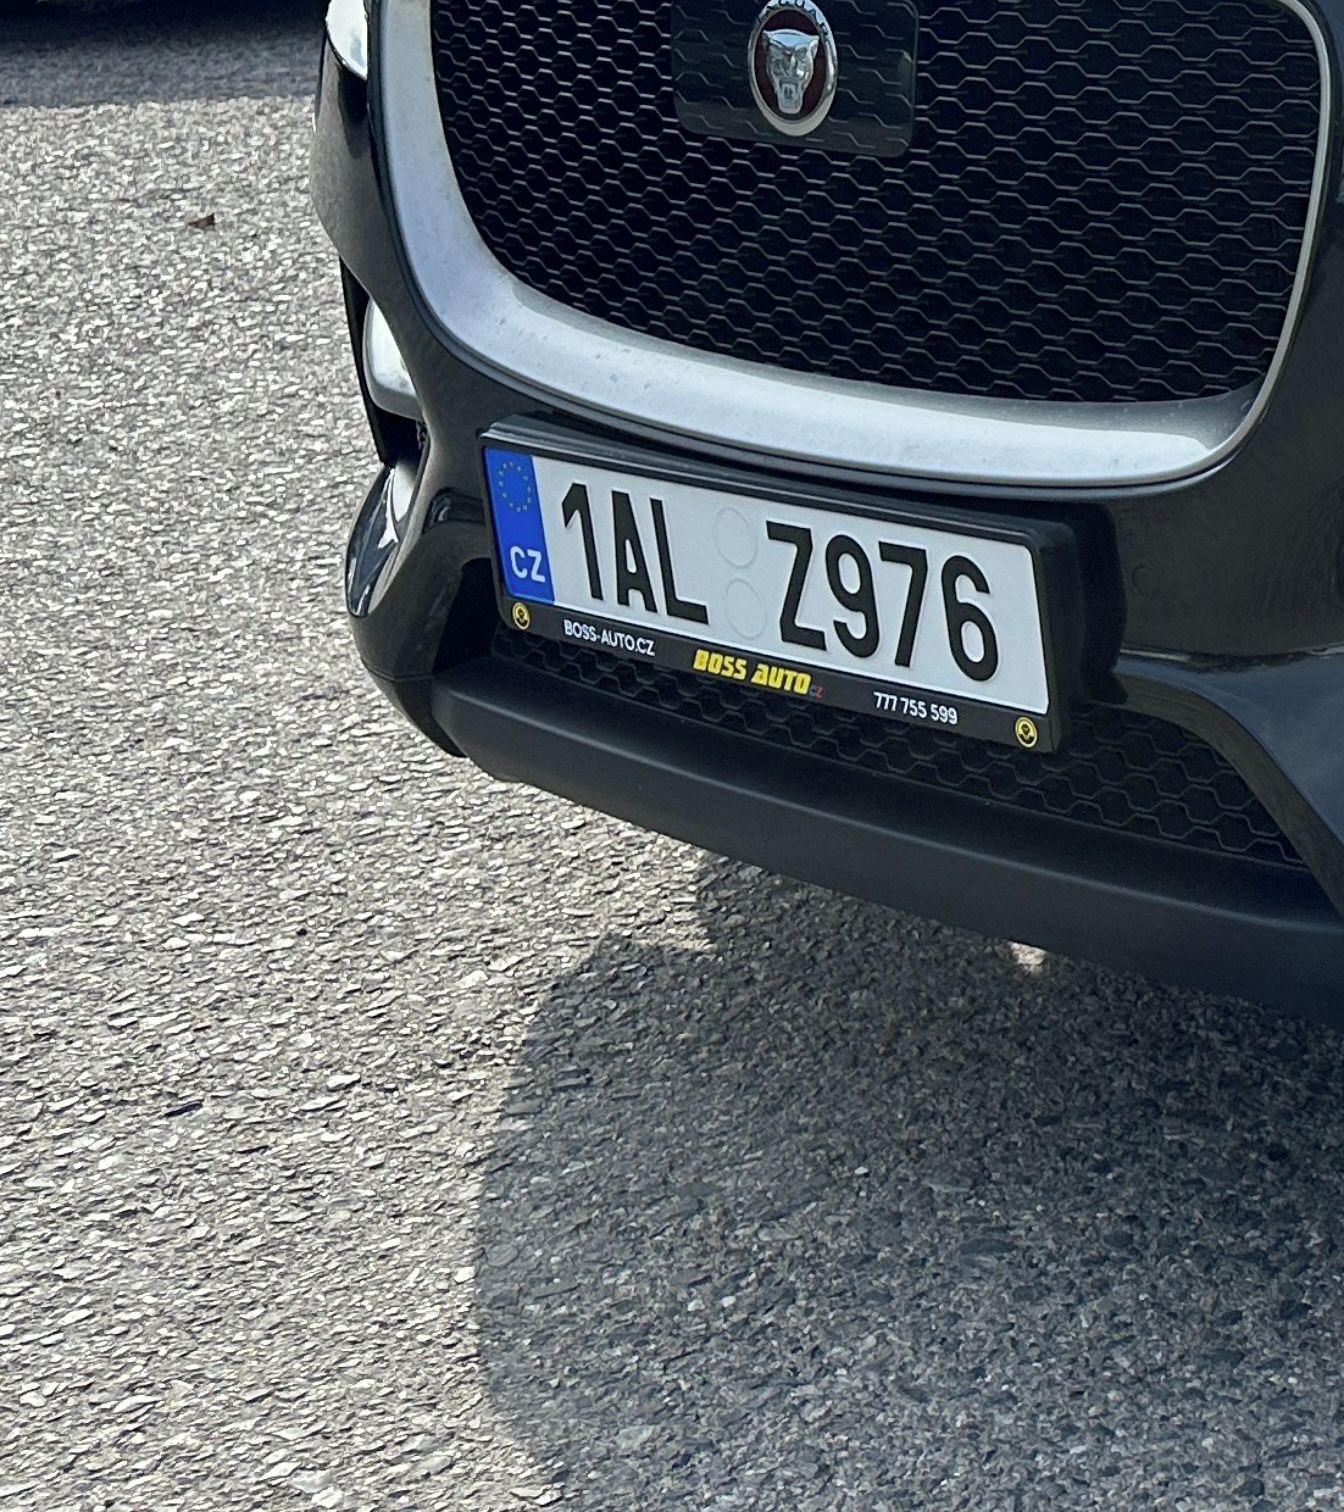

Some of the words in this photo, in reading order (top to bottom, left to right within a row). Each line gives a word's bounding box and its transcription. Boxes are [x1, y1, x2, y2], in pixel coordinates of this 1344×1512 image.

[510, 545, 546, 583] CZ
[561, 482, 709, 626] 1AL
[766, 520, 999, 683] Z976
[563, 619, 656, 657] BOSS-AUTO.CZ
[693, 649, 748, 681] BOSS
[751, 663, 812, 696] AUTO
[873, 691, 897, 713] 777
[900, 697, 928, 719] 755
[930, 703, 958, 726] 599
